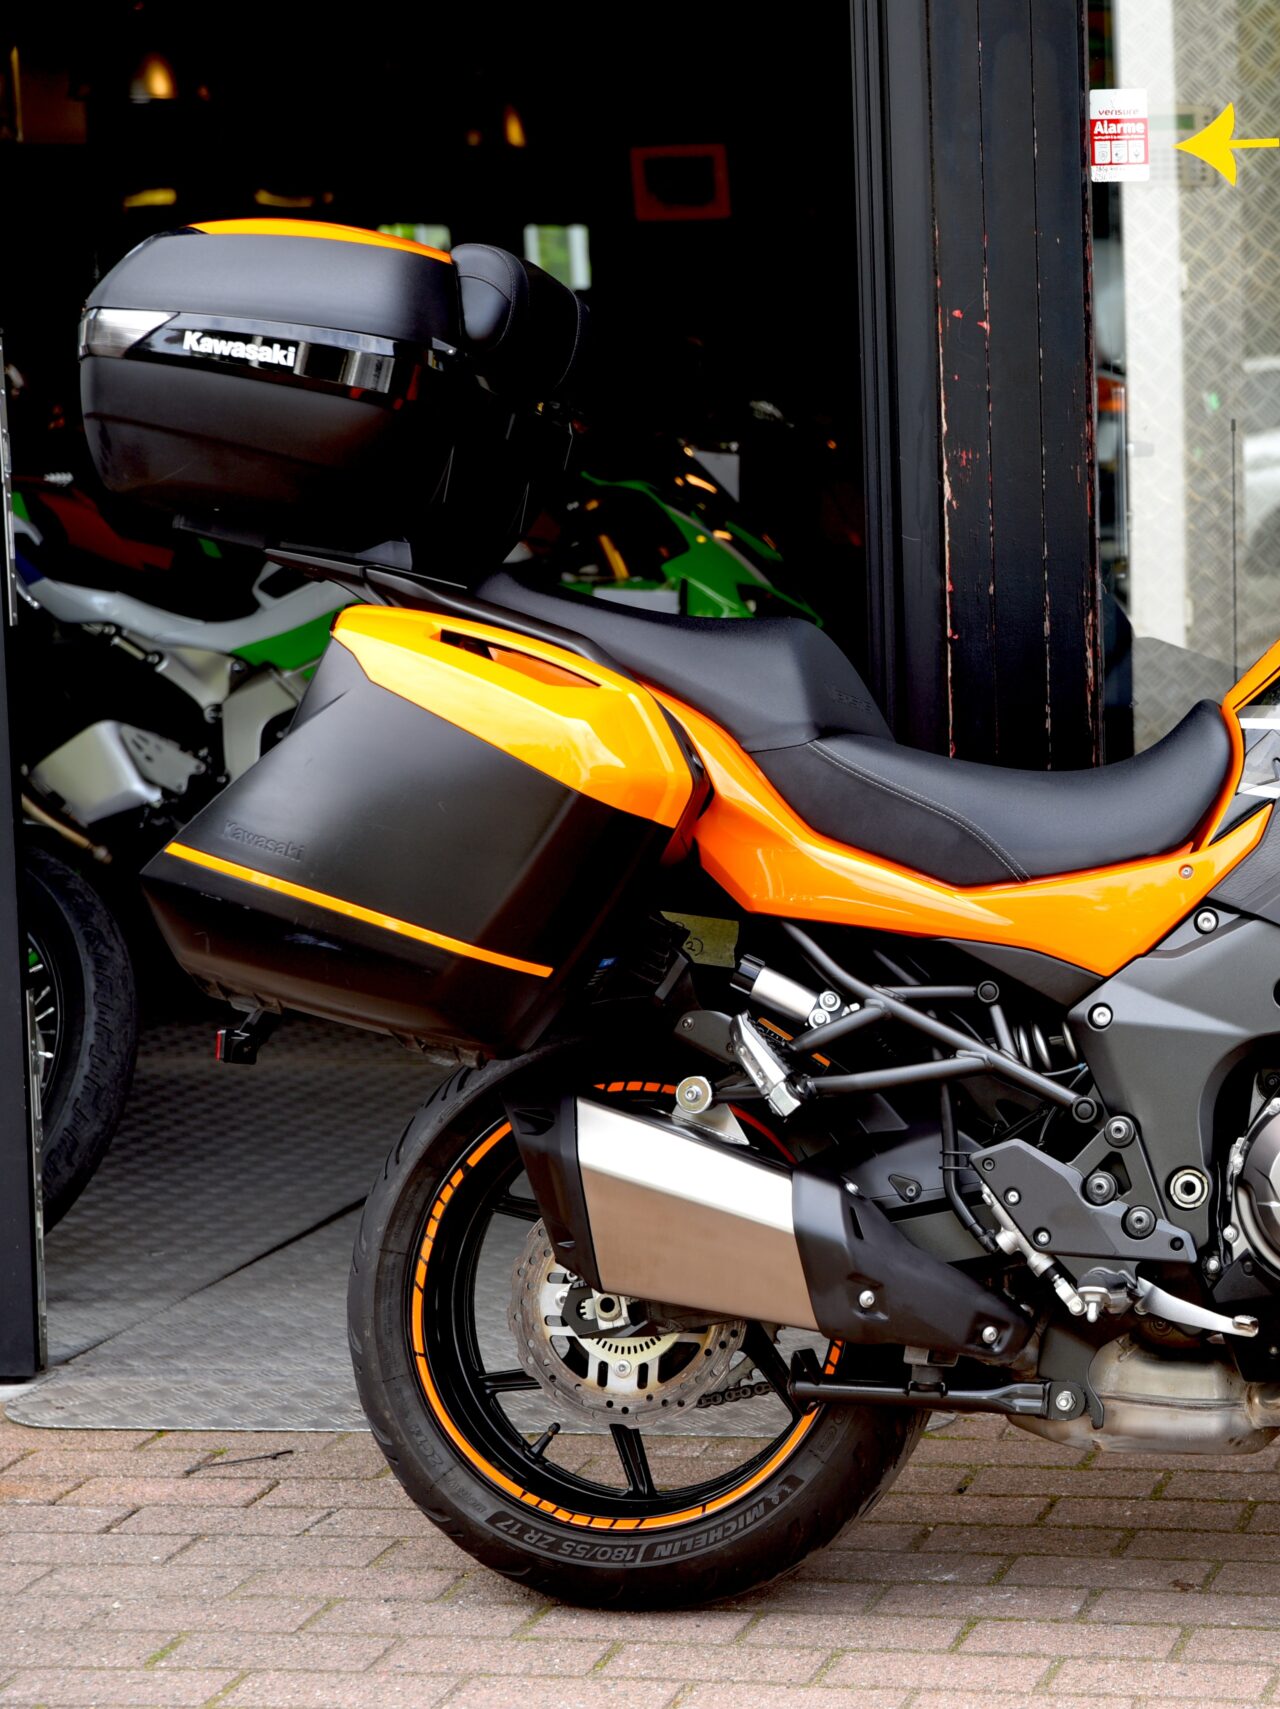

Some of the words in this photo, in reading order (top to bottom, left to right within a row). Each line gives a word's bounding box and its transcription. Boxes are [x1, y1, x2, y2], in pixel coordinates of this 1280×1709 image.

[1094, 120, 1145, 134] Alarme
[182, 330, 296, 367] Kawasaki
[223, 821, 305, 861] Kawasaki
[496, 1518, 521, 1535] 17
[654, 1503, 767, 1558] MICHELIN
[522, 1528, 556, 1548] ZR
[558, 1540, 637, 1561] 180/55
